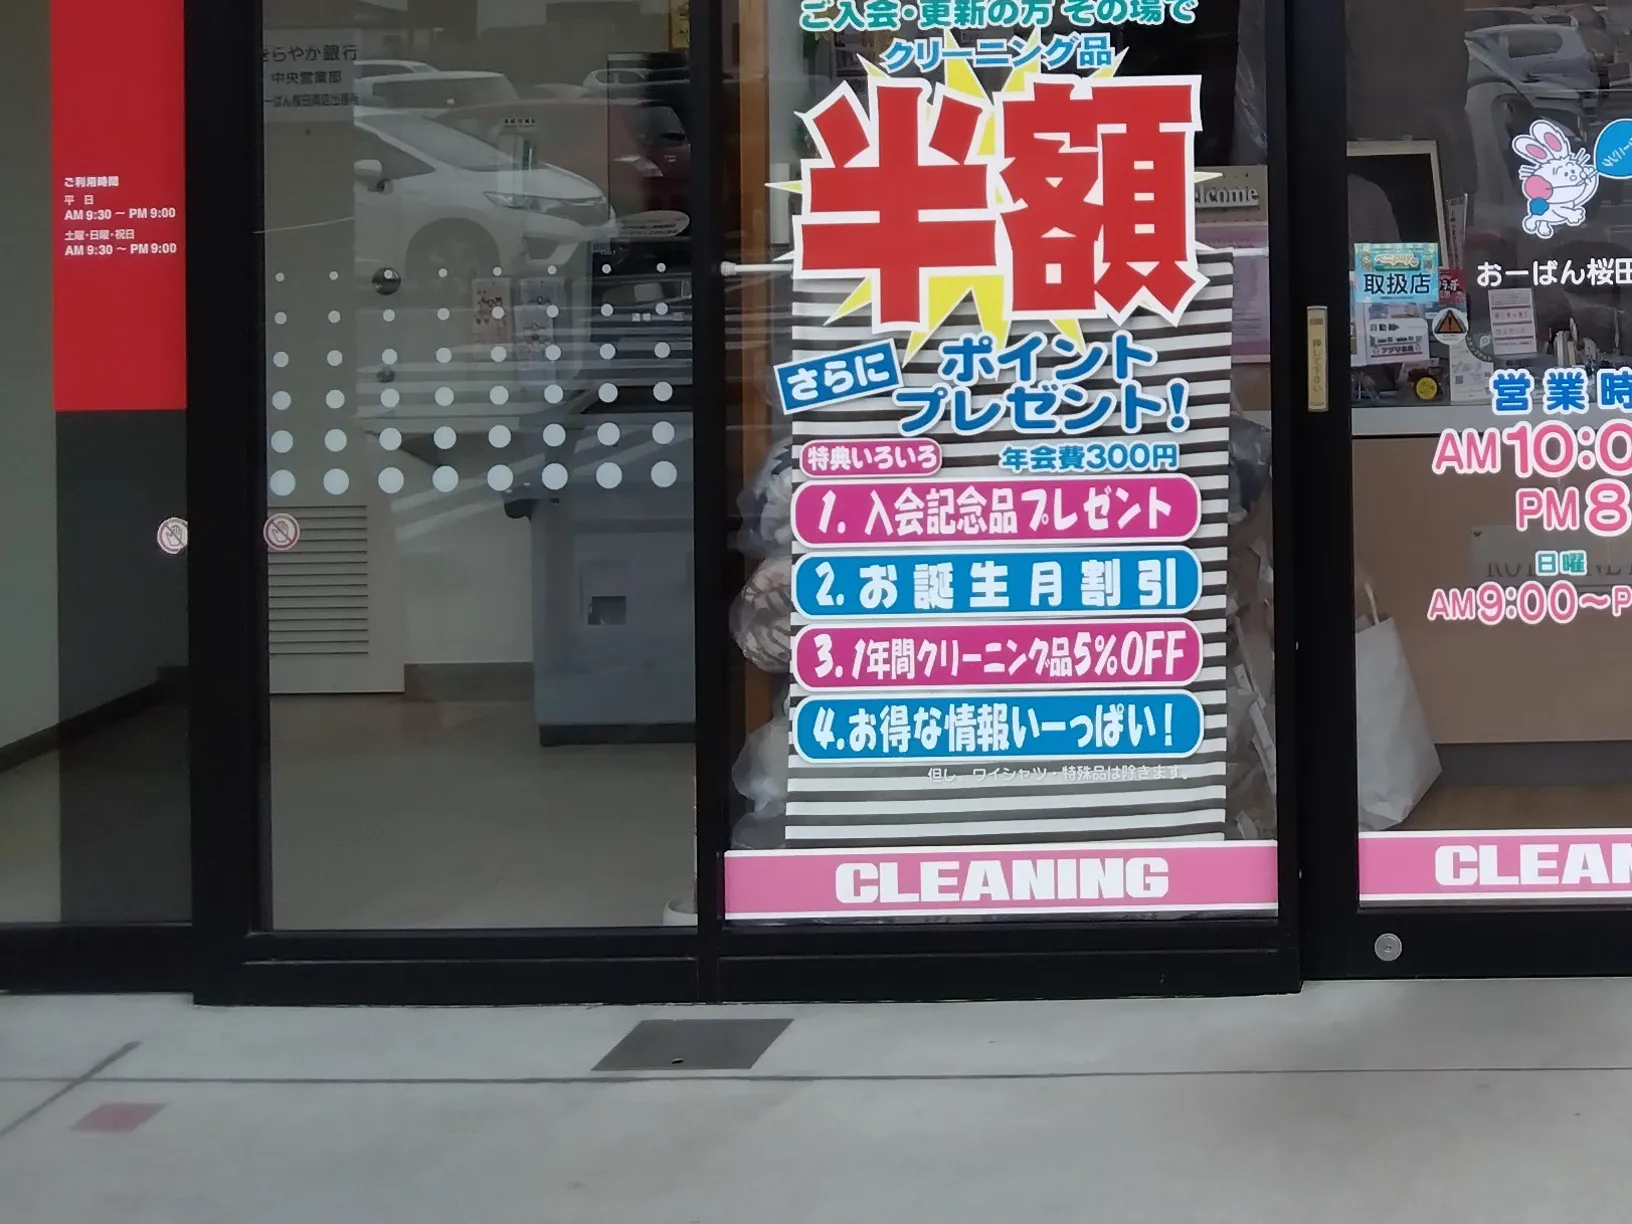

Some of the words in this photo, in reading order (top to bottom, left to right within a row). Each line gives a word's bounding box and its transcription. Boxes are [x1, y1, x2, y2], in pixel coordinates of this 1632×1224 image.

[881, 33, 1114, 74] クリーニング品
[64, 176, 120, 188] ご利用時間
[1195, 183, 1259, 207] lcome
[64, 209, 84, 221] AM
[86, 209, 112, 221] 9:30
[129, 208, 147, 220] PM
[150, 207, 176, 219] 9:00
[793, 73, 1209, 333] 半額
[64, 244, 84, 256] AM
[87, 244, 113, 256] 9:30
[130, 243, 149, 255] PM
[151, 242, 177, 254] 9:00
[1364, 273, 1431, 295] 取扱店
[939, 331, 1157, 383] ポイント
[786, 350, 892, 399] さらに
[893, 378, 1191, 435] プレゼント!
[807, 444, 938, 471] 特典いろいろ
[999, 444, 1179, 472] 年会費300円
[1535, 550, 1587, 576] 日曜
[835, 856, 1168, 904] CLEANING
